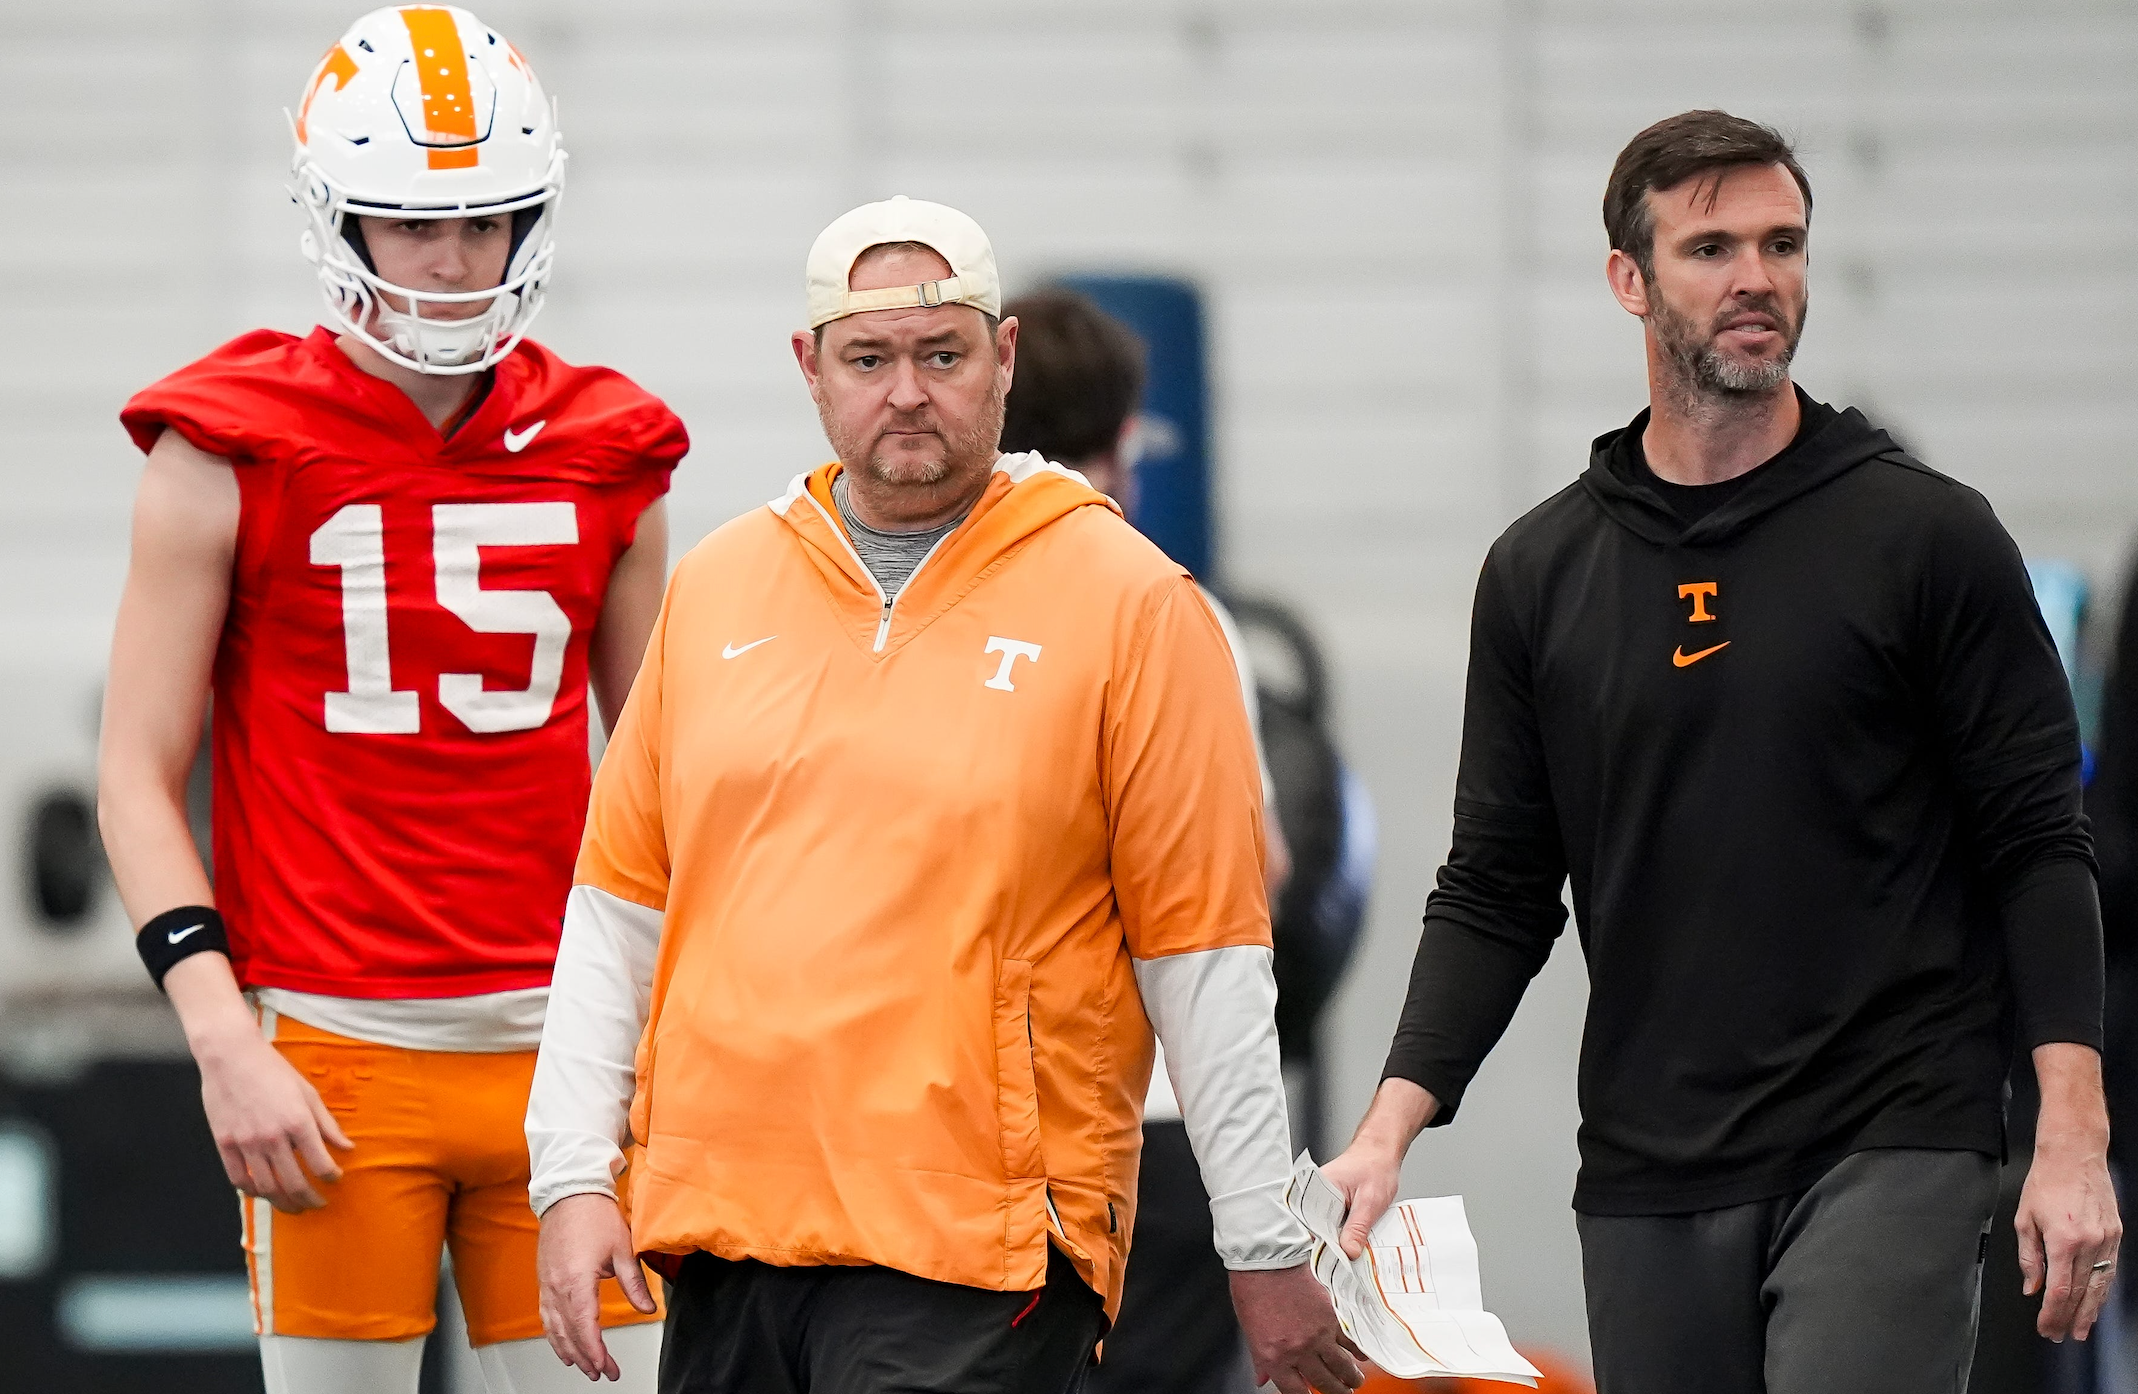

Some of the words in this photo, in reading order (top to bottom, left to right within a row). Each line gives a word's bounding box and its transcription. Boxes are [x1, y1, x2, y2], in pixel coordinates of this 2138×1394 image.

[309, 501, 580, 734] 15
[1676, 581, 1719, 622] T
[984, 635, 1042, 692] T
